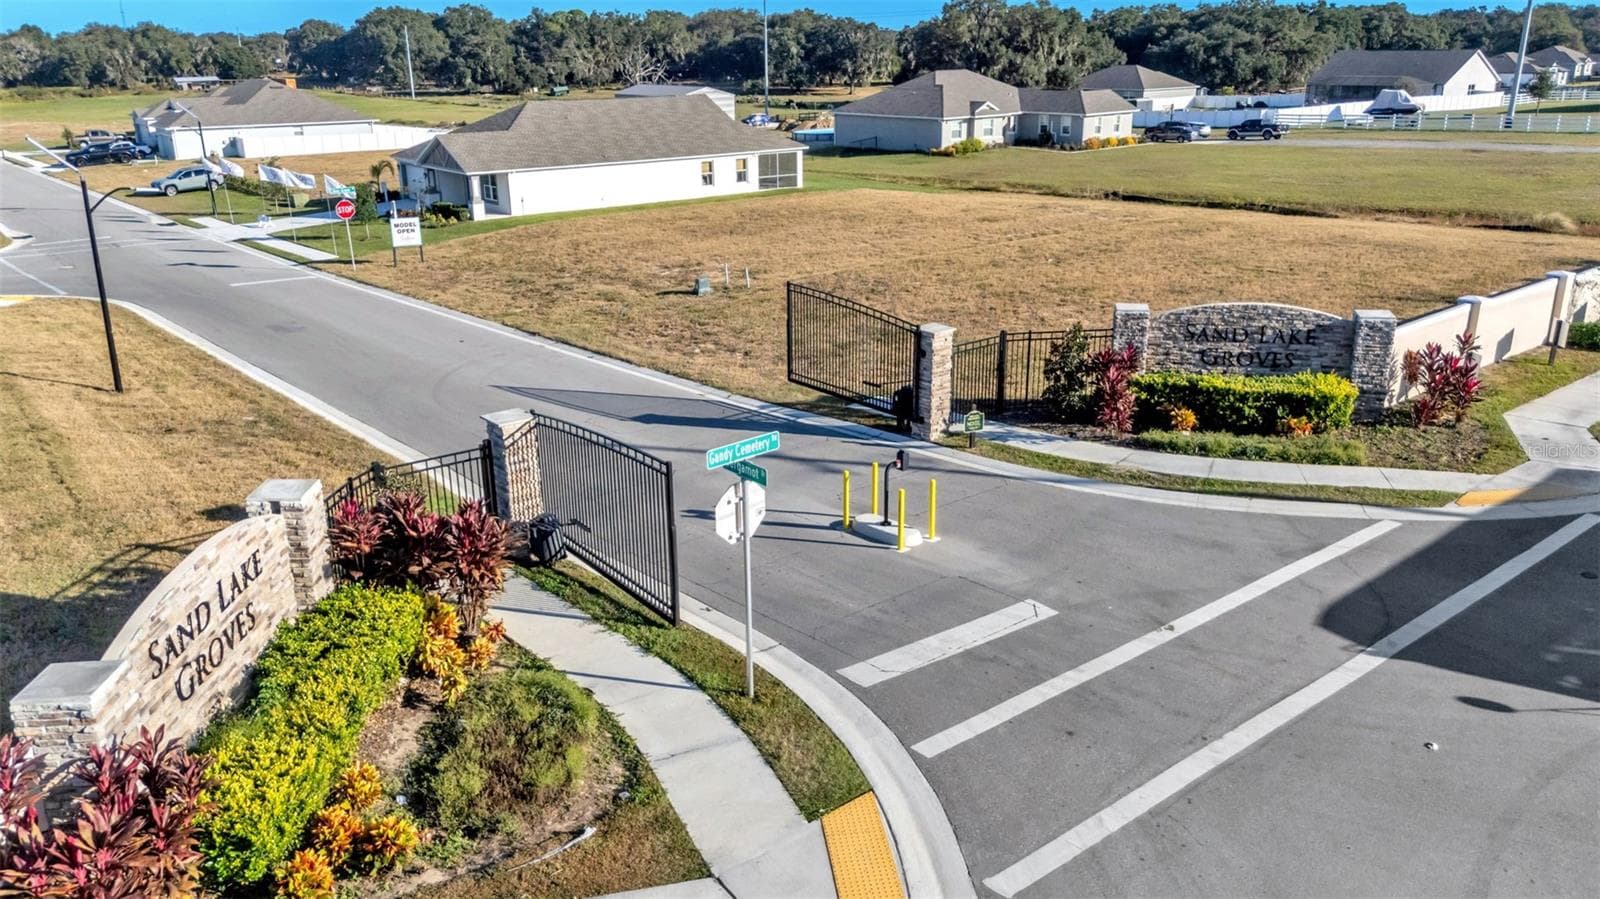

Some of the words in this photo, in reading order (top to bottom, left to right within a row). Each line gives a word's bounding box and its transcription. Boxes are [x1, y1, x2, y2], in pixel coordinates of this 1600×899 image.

[337, 205, 354, 214] STOP
[393, 221, 417, 229] MODEL
[1184, 324, 1250, 343] SAND
[1260, 325, 1320, 346] LAKE
[1199, 347, 1296, 369] GROVES
[708, 447, 734, 465] Gandy
[735, 436, 771, 457] Cemetery
[728, 461, 760, 481] ergamot
[147, 600, 212, 680] SAND
[216, 548, 264, 613] LAKE
[174, 601, 257, 702] GROVES
